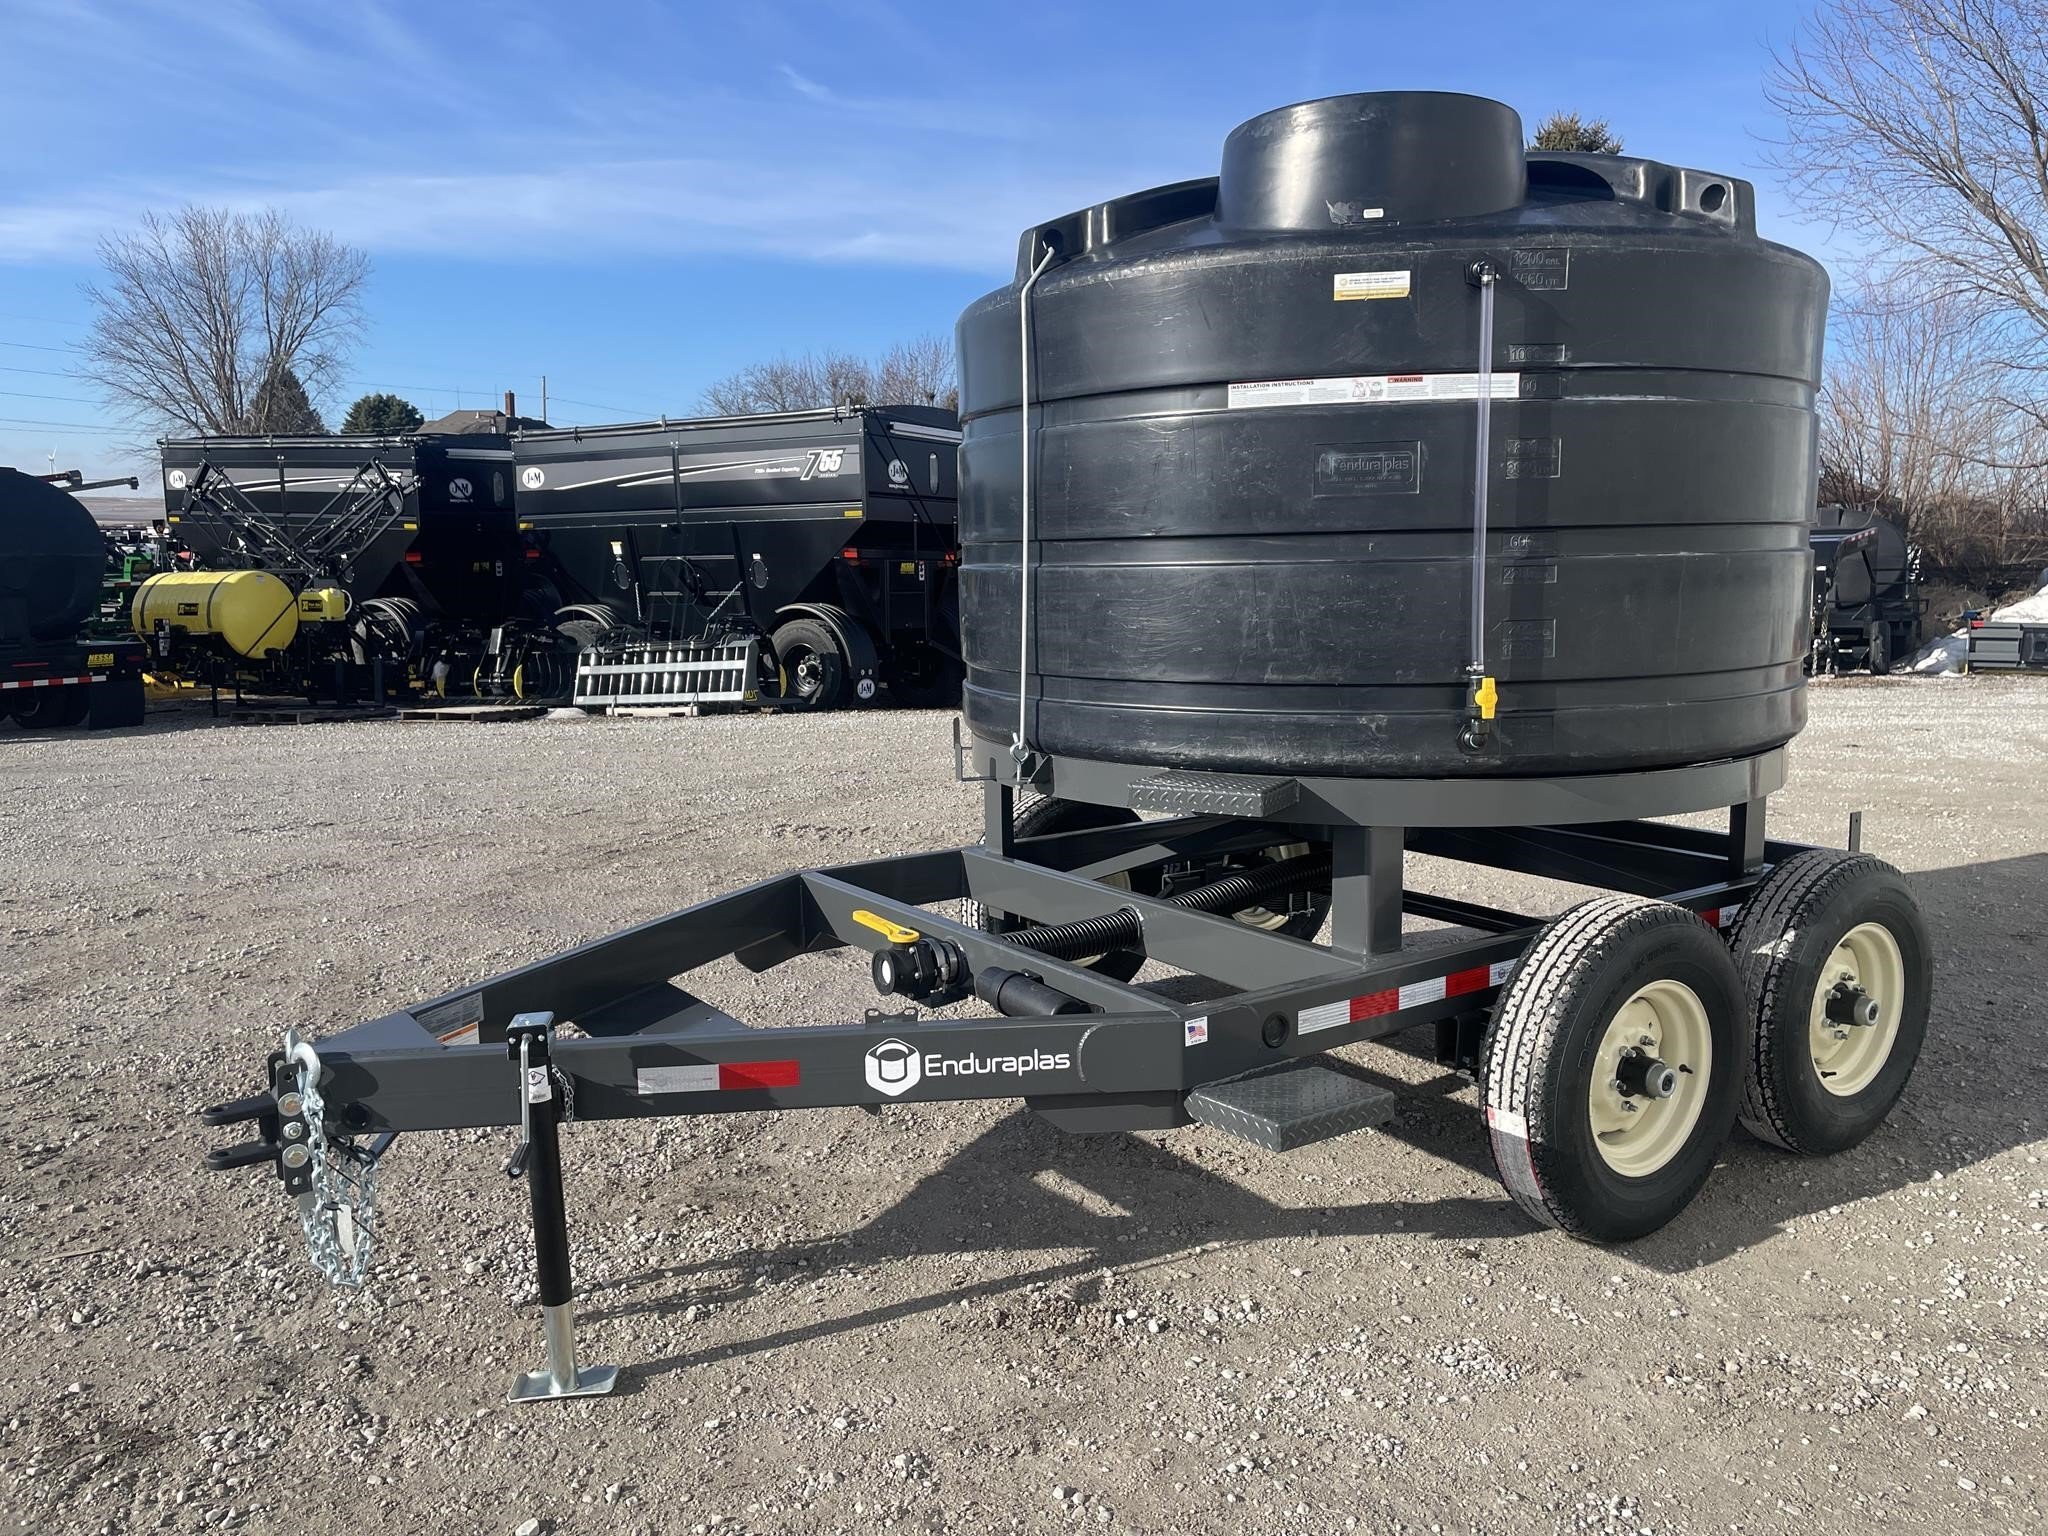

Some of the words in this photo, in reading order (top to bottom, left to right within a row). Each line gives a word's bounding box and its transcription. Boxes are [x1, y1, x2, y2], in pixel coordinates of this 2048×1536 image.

[1271, 380, 1315, 388] INSTRUCTIONS
[800, 449, 844, 481] 755
[924, 1048, 1071, 1077] Enduraplas
